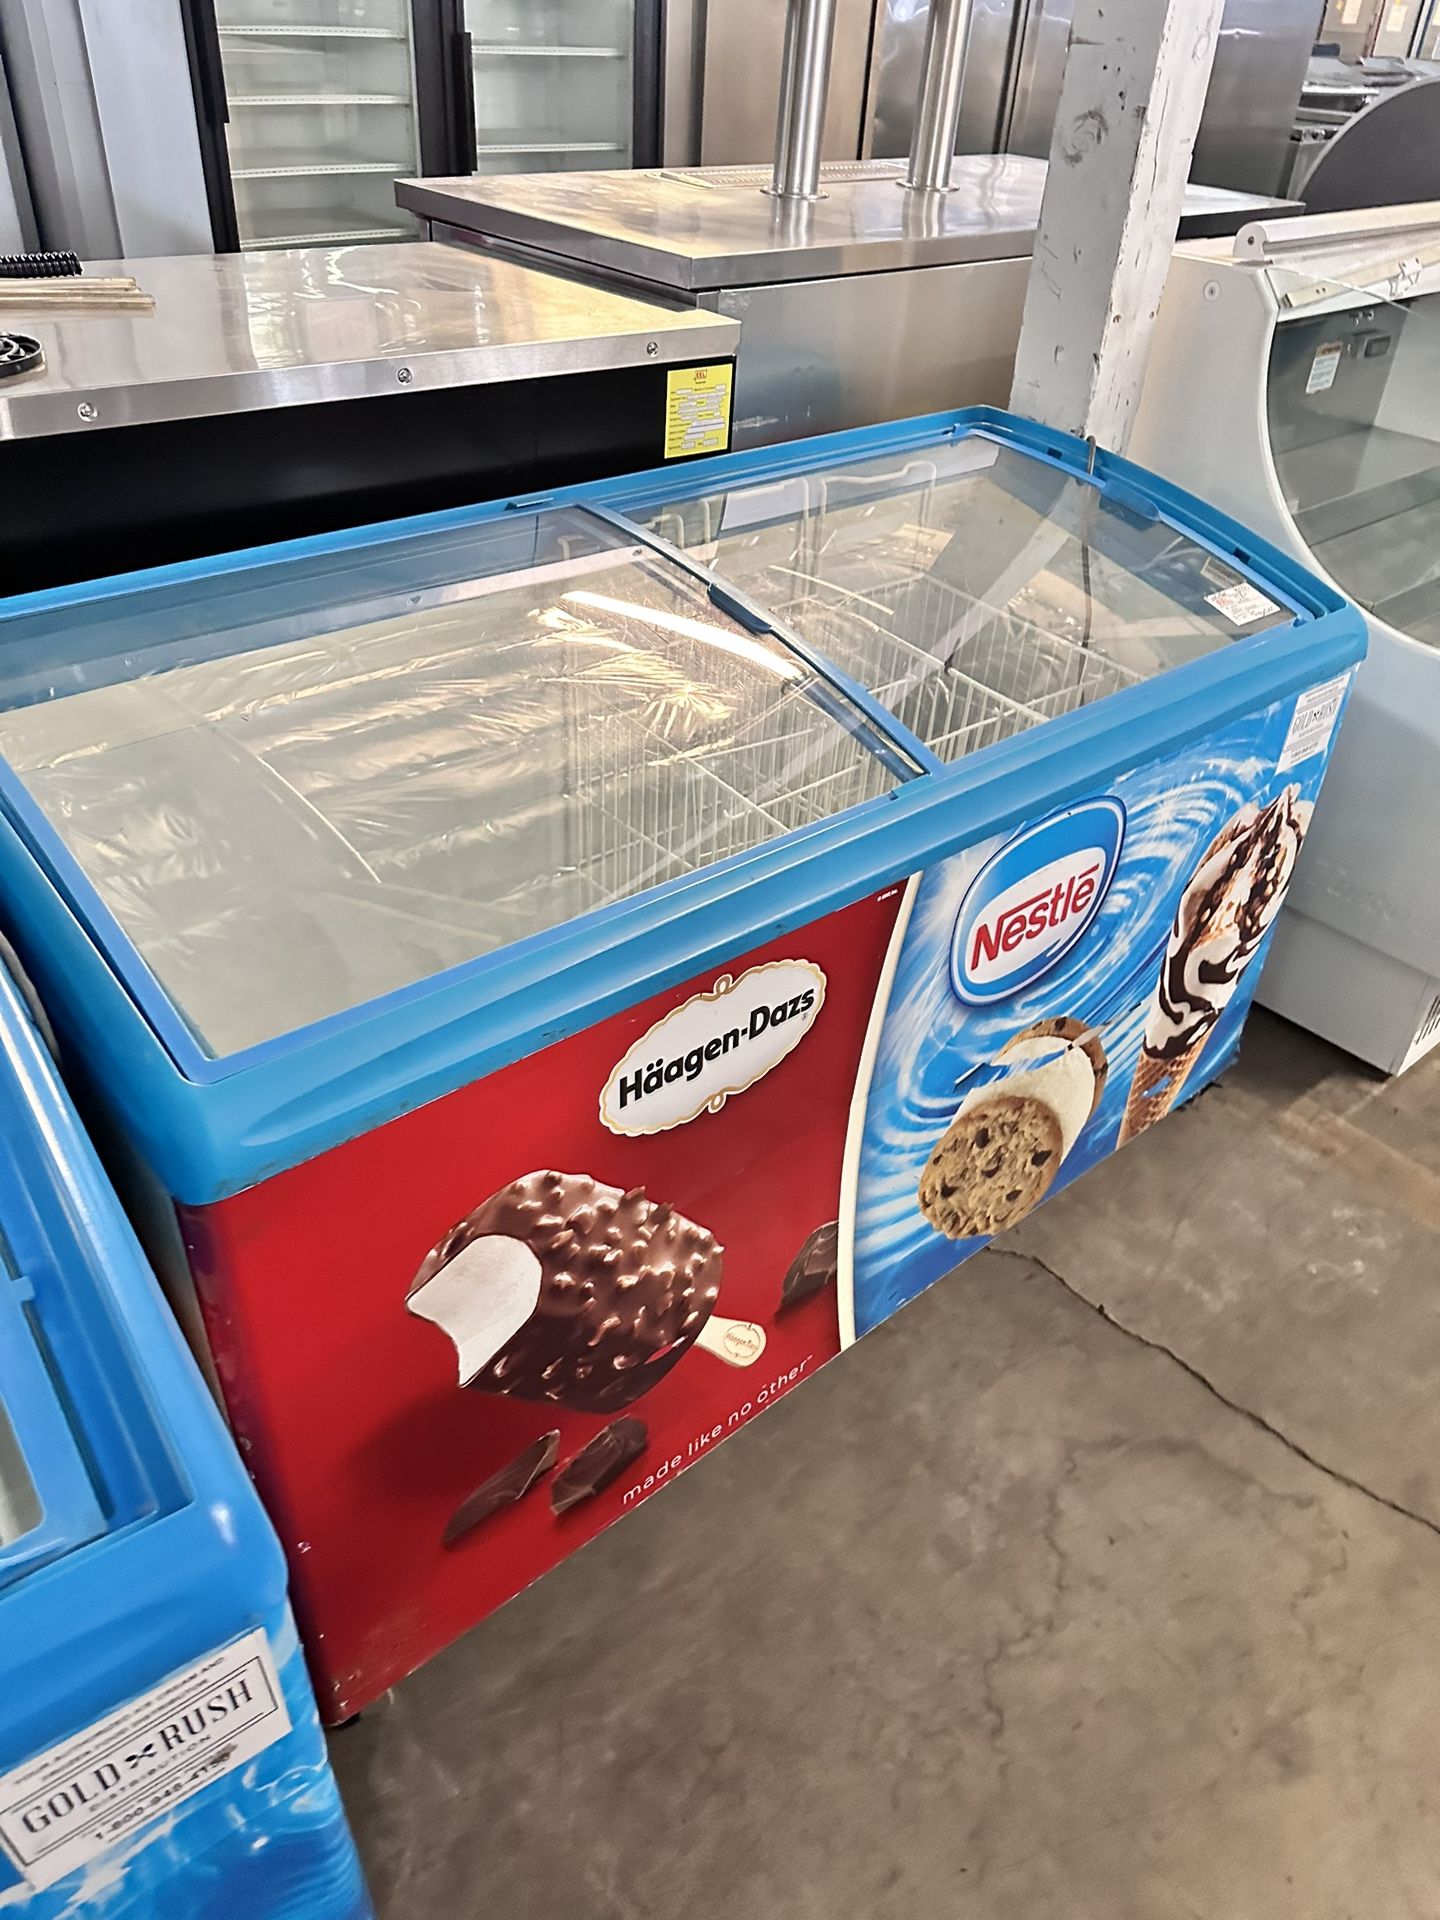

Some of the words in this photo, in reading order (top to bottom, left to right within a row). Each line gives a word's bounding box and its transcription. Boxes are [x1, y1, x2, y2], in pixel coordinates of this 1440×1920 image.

[970, 863, 1100, 971] Nestlé
[618, 987, 815, 1110] Häagen-Dazs
[623, 1454, 682, 1505] made
[688, 1423, 722, 1456] like
[728, 1402, 752, 1426] no
[22, 1762, 121, 1834] GOLD
[158, 1679, 253, 1751] RUSH
[89, 1735, 211, 1812] DISTRIBUTION
